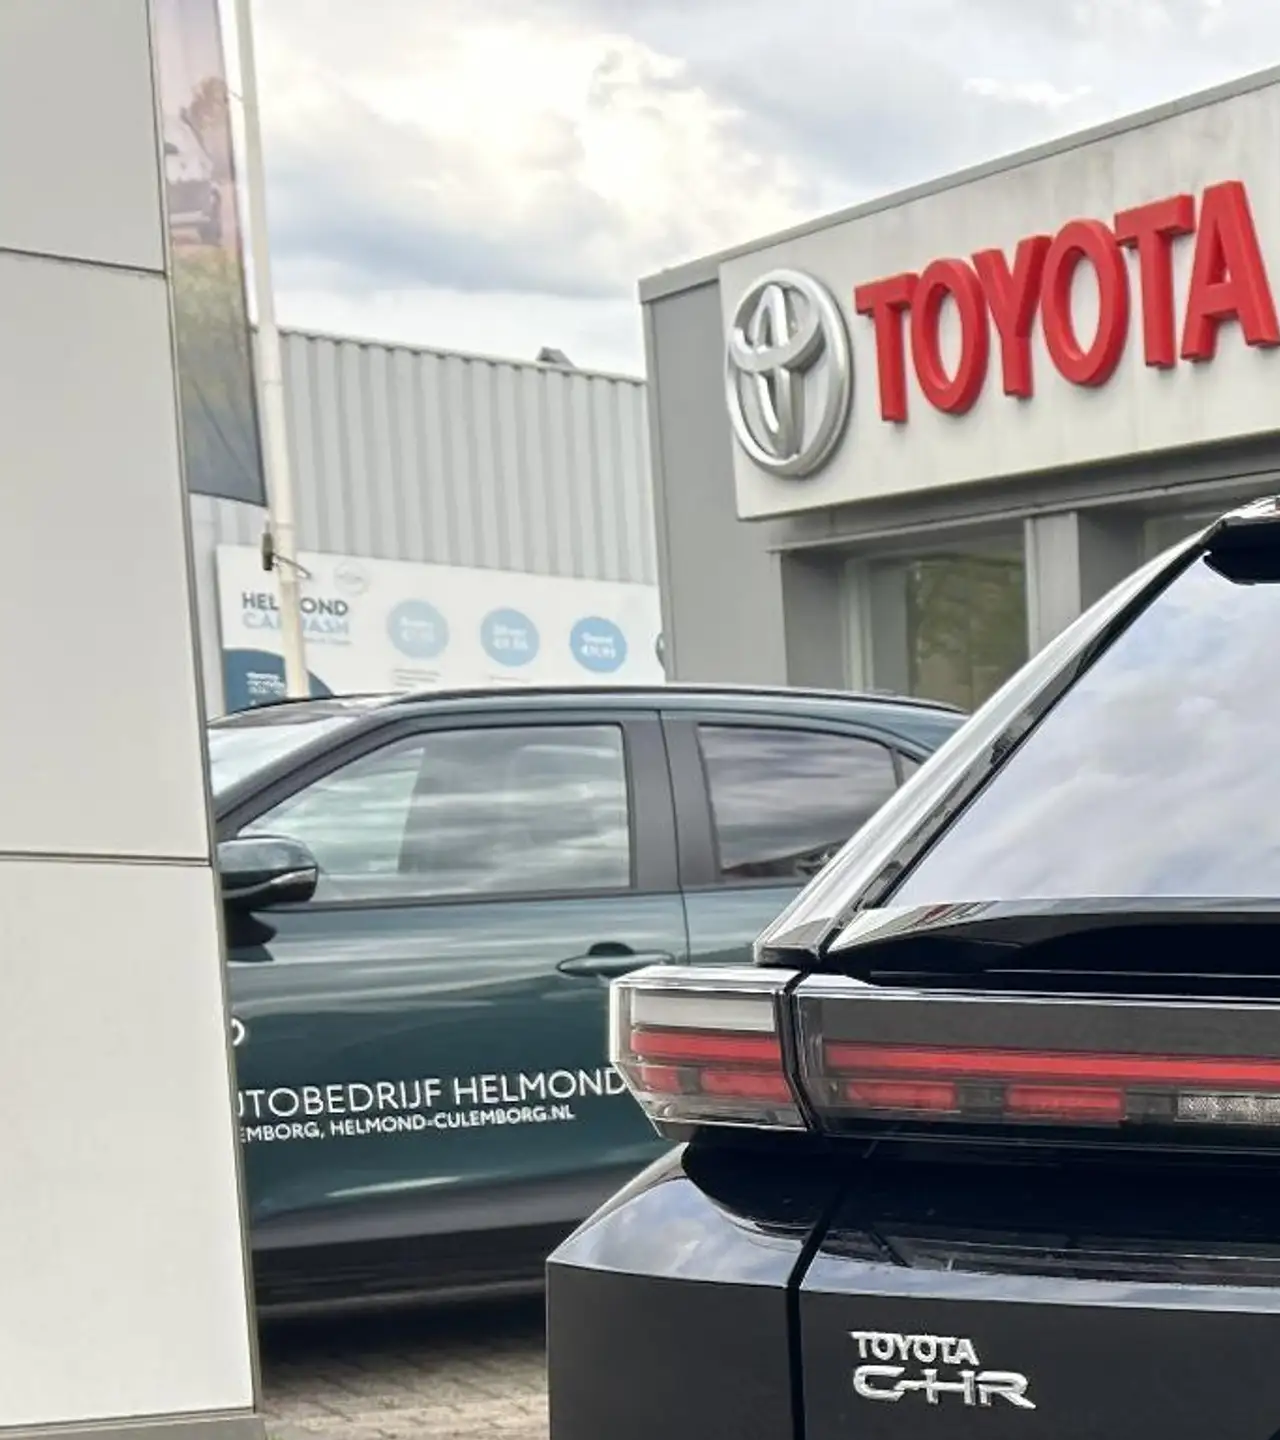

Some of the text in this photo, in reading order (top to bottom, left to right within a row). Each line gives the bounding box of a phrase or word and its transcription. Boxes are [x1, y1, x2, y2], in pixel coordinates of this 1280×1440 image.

[242, 592, 349, 617] HELOND
[238, 1066, 627, 1119] TOBEDRIJF HELMOND
[329, 1103, 576, 1138] HELMOND-CULEMBORG.NL
[850, 1331, 980, 1366] TOYOTA
